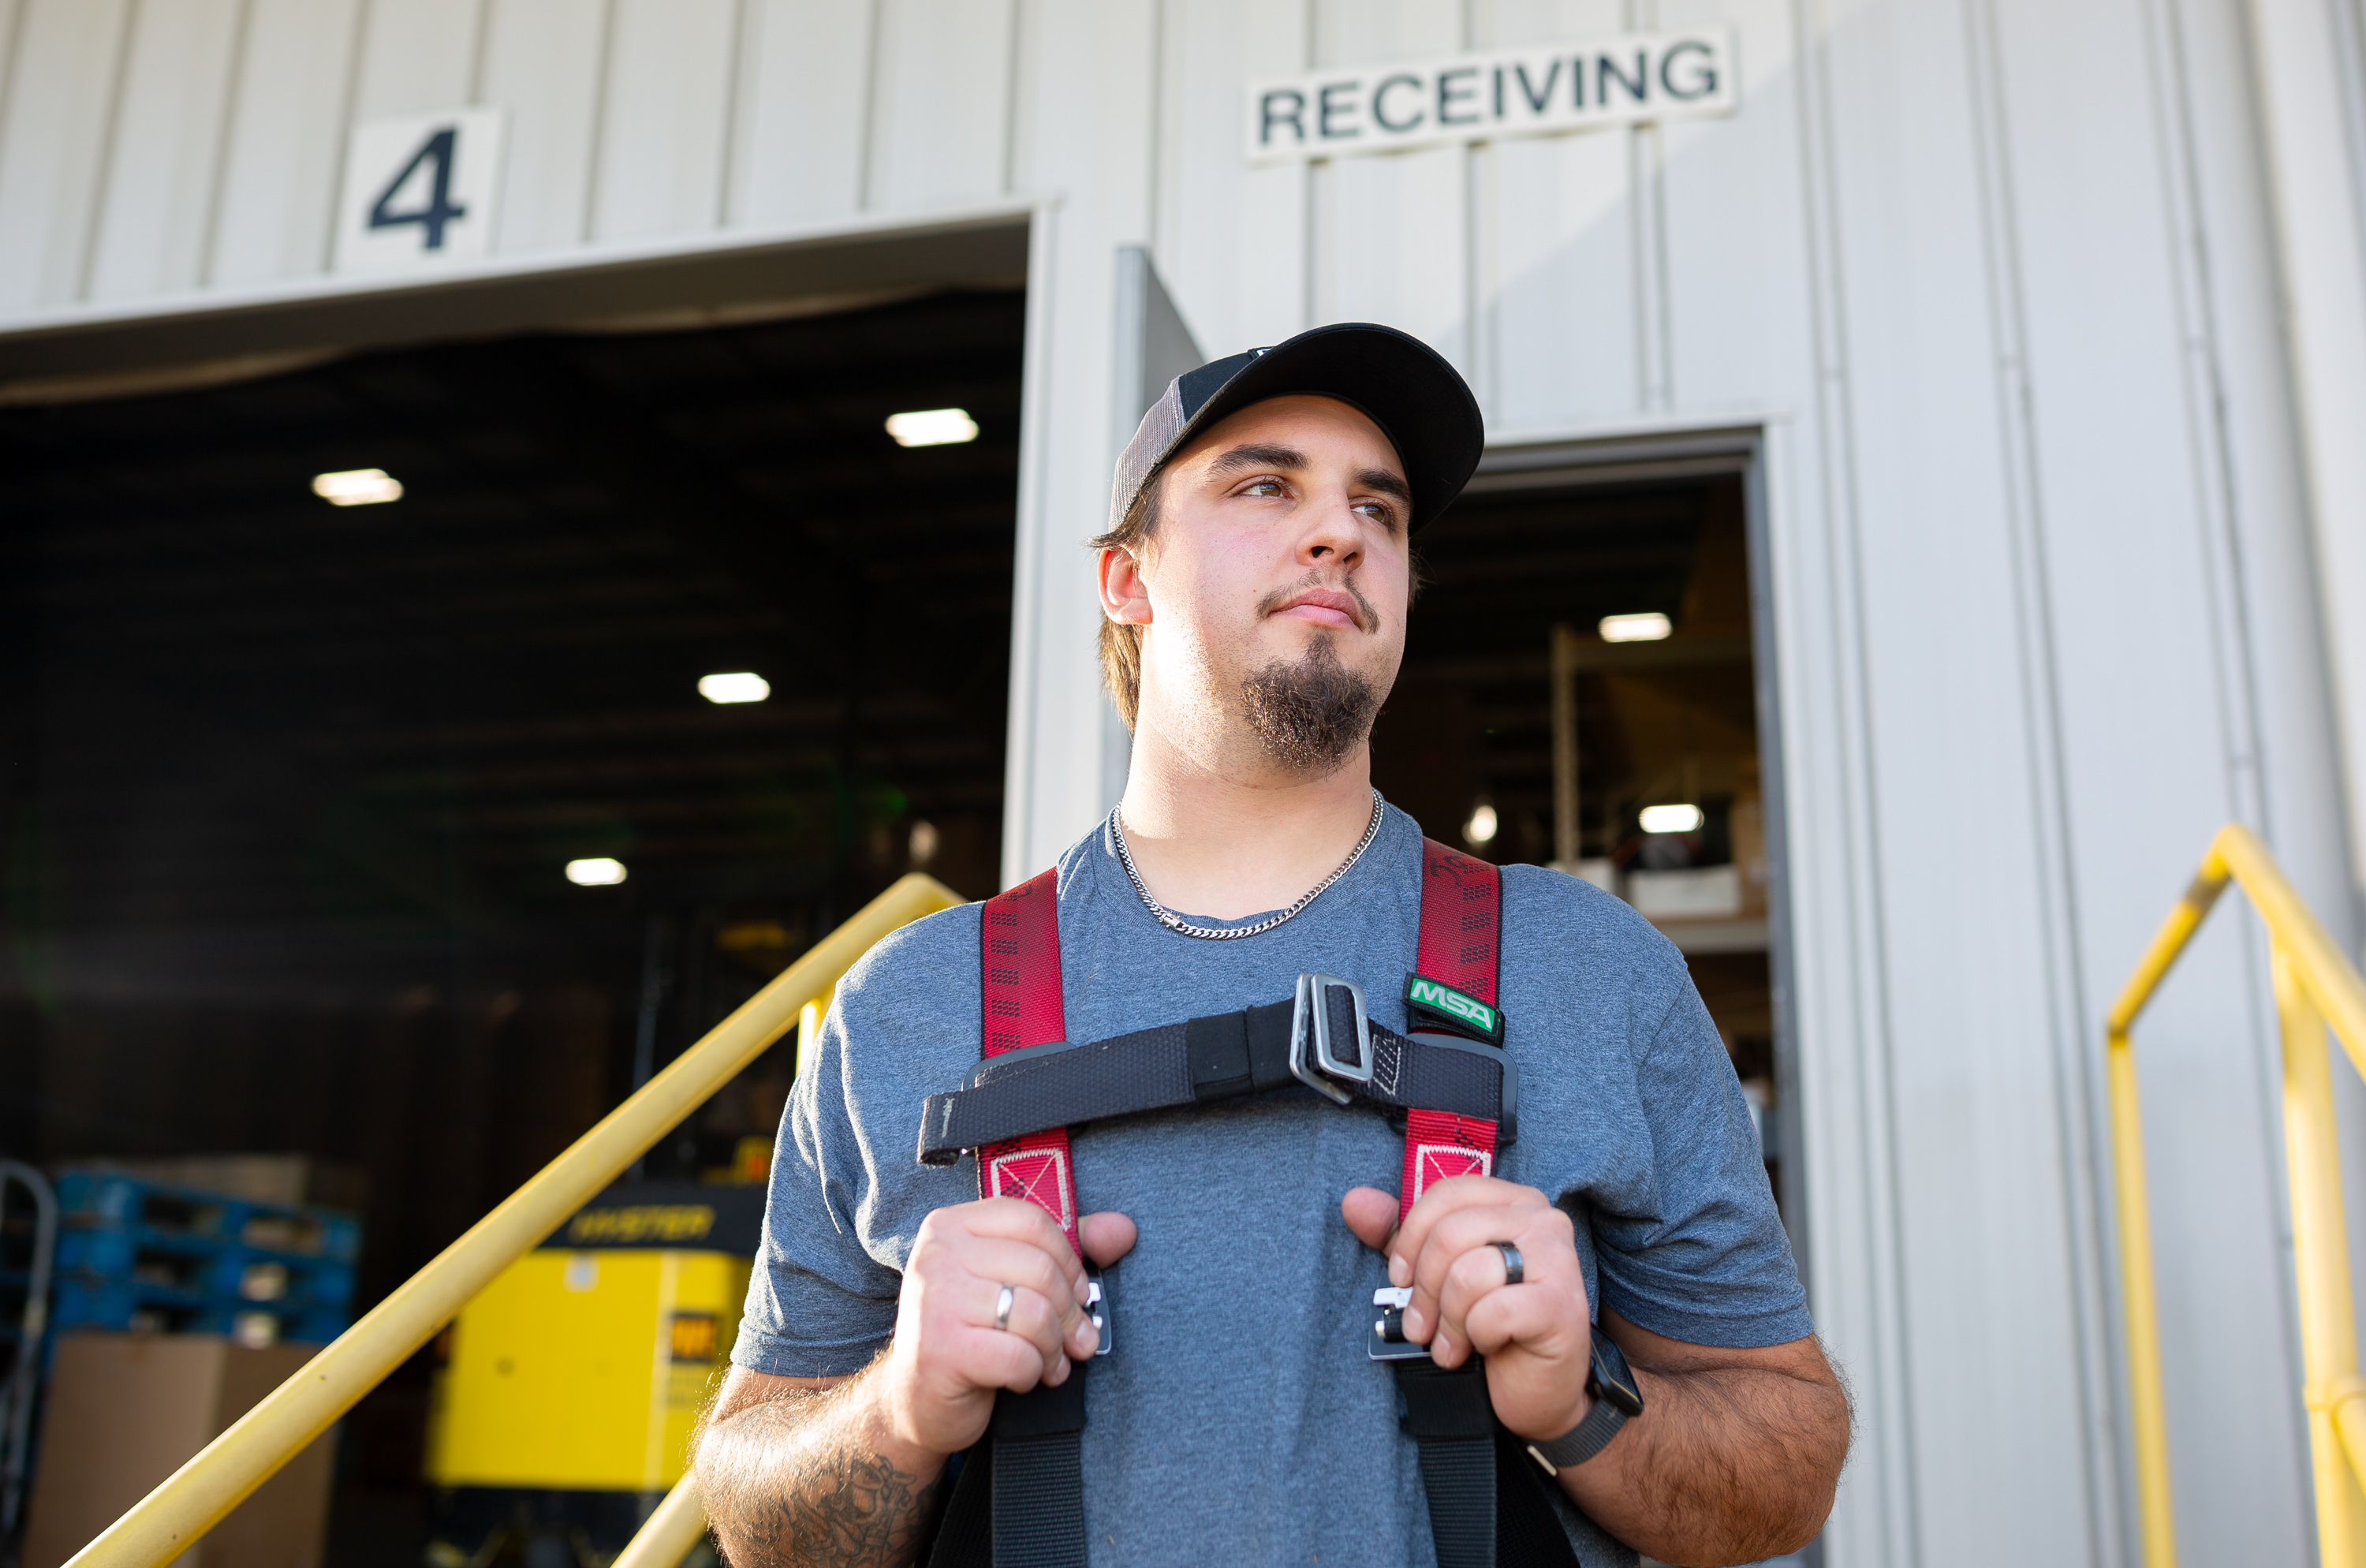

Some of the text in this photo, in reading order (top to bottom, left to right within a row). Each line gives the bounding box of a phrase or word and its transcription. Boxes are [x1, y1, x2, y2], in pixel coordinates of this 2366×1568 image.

[1258, 40, 1722, 145] RECEIVING
[368, 125, 465, 250] 4
[1411, 981, 1492, 1030] MSA
